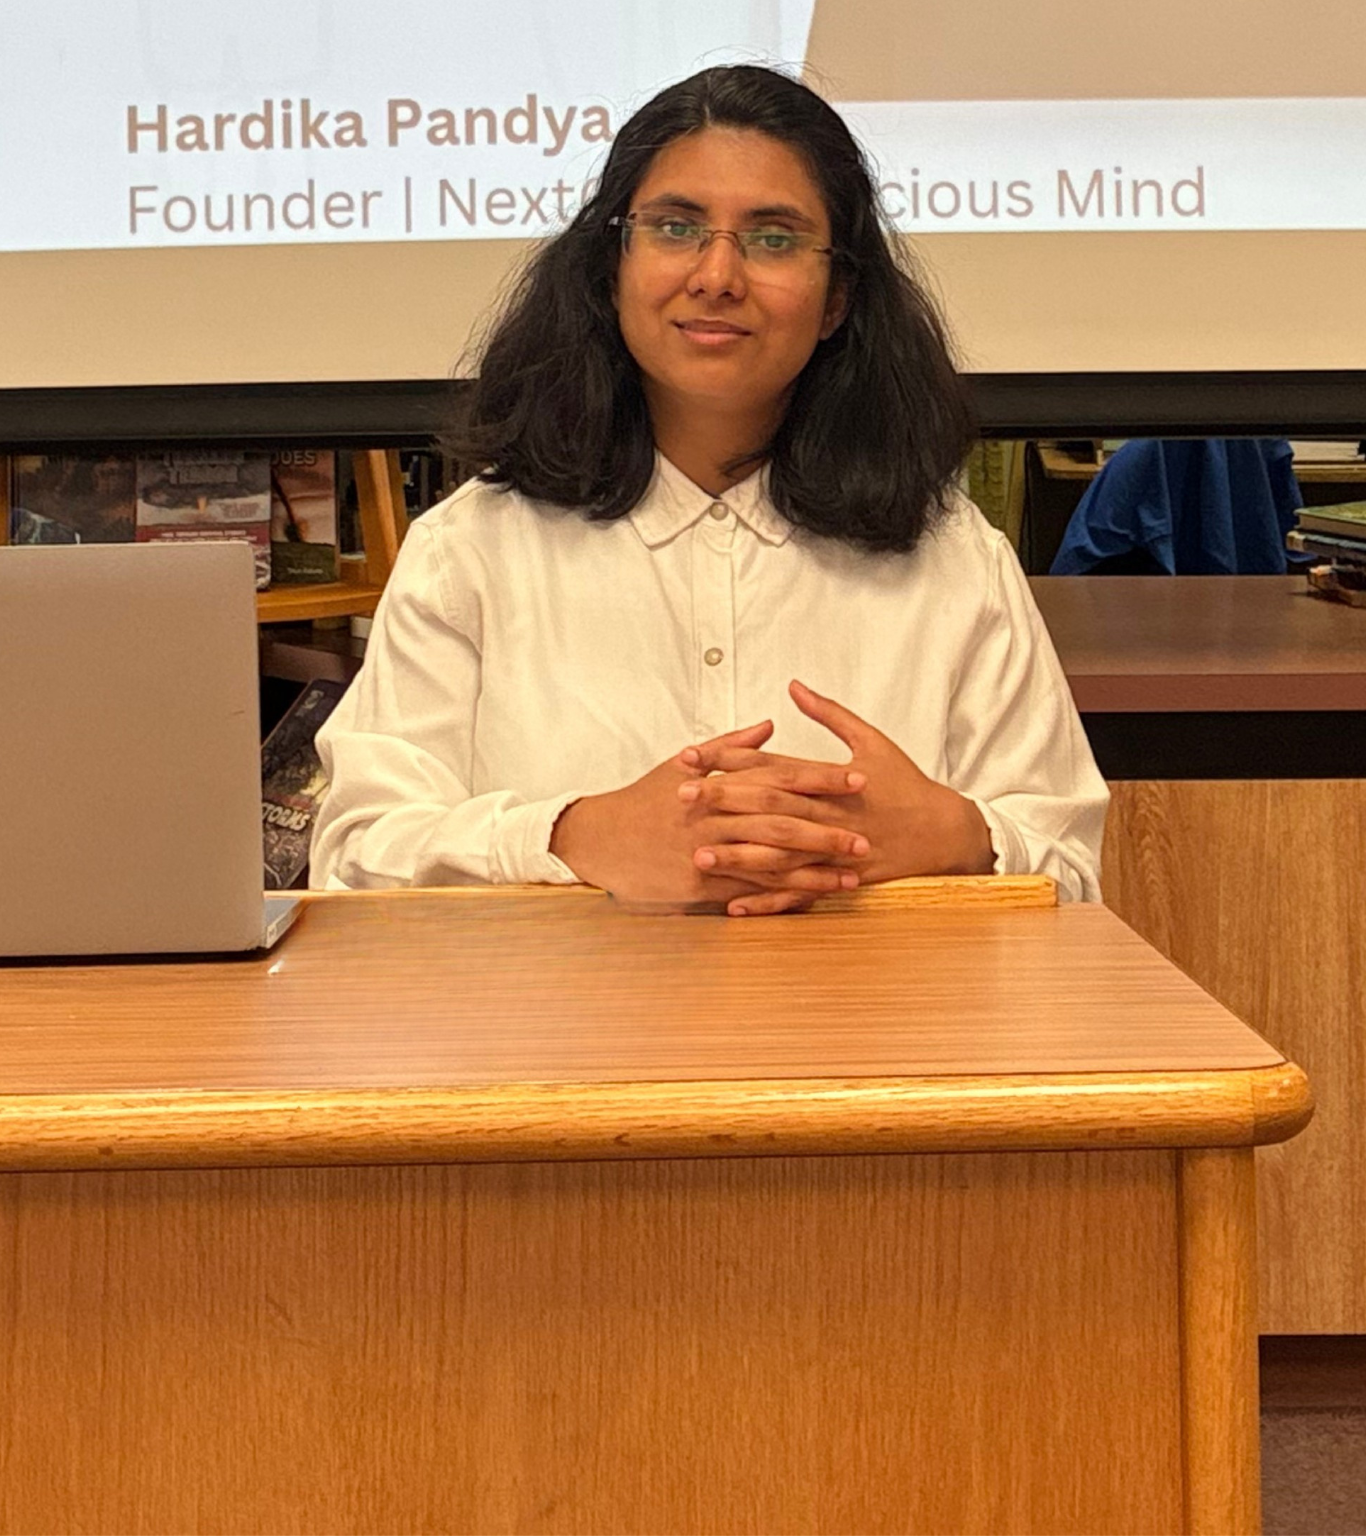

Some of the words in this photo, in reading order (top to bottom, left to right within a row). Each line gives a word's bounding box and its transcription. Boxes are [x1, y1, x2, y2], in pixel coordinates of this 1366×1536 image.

[127, 98, 367, 153] Hardika
[388, 93, 612, 157] Pandya
[130, 179, 382, 234] Founder
[1057, 166, 1205, 217] Mind
